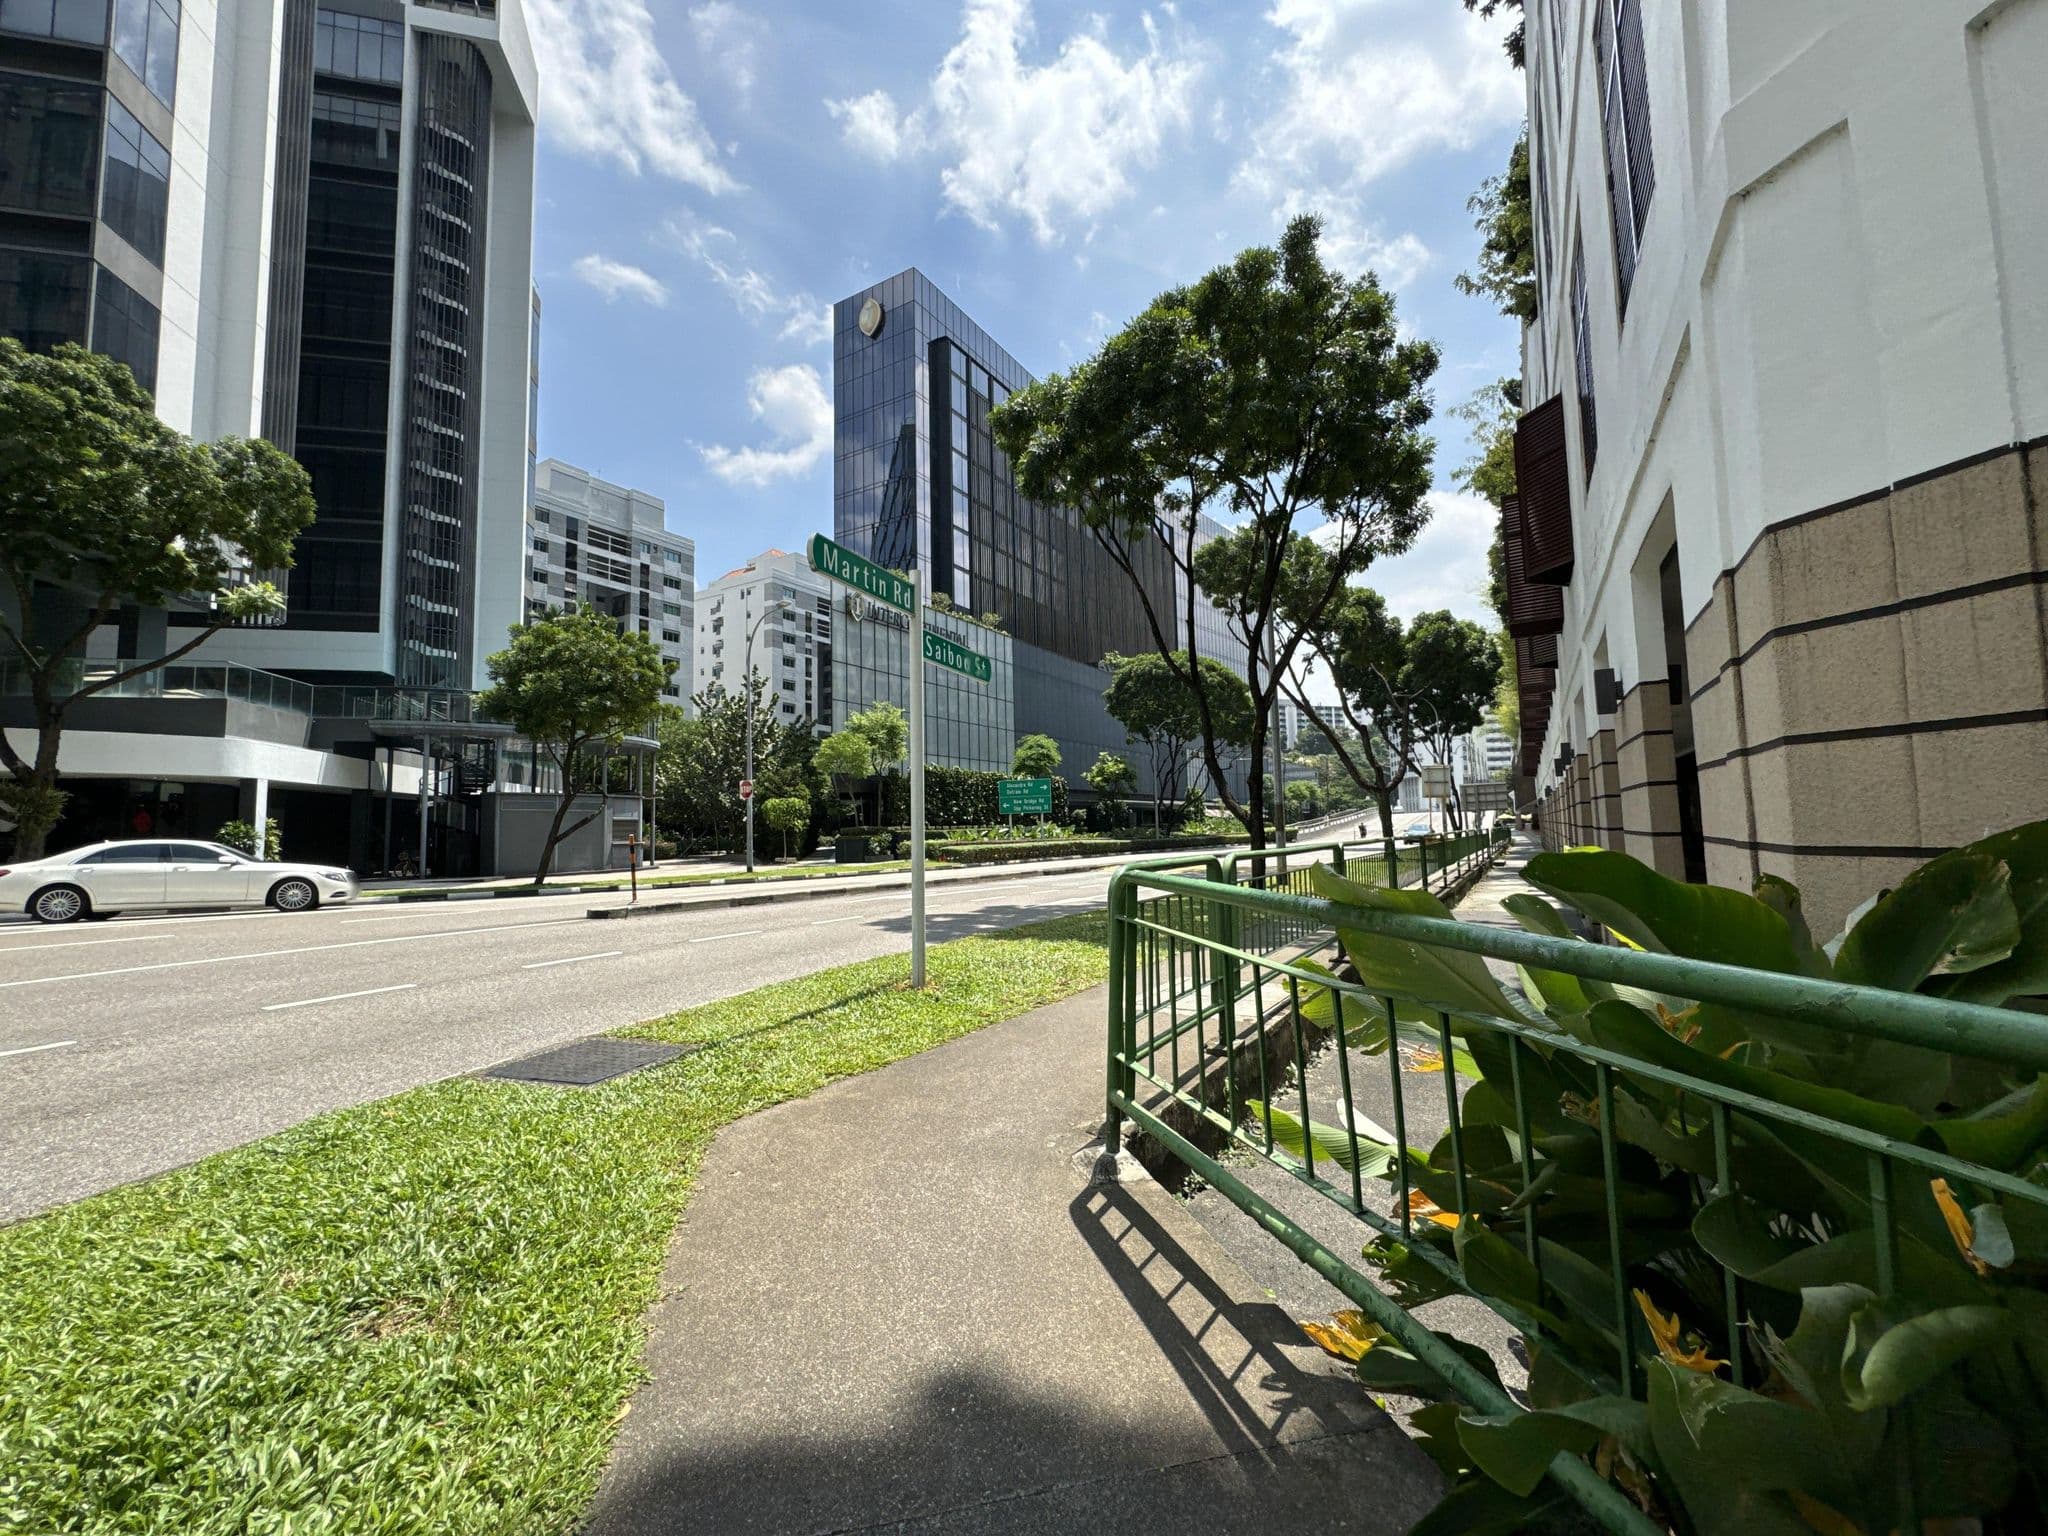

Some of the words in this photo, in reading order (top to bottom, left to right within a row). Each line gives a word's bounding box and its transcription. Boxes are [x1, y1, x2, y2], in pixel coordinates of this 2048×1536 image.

[823, 543, 887, 598] Martin
[893, 580, 911, 609] Rd
[926, 635, 971, 673] Saiboo
